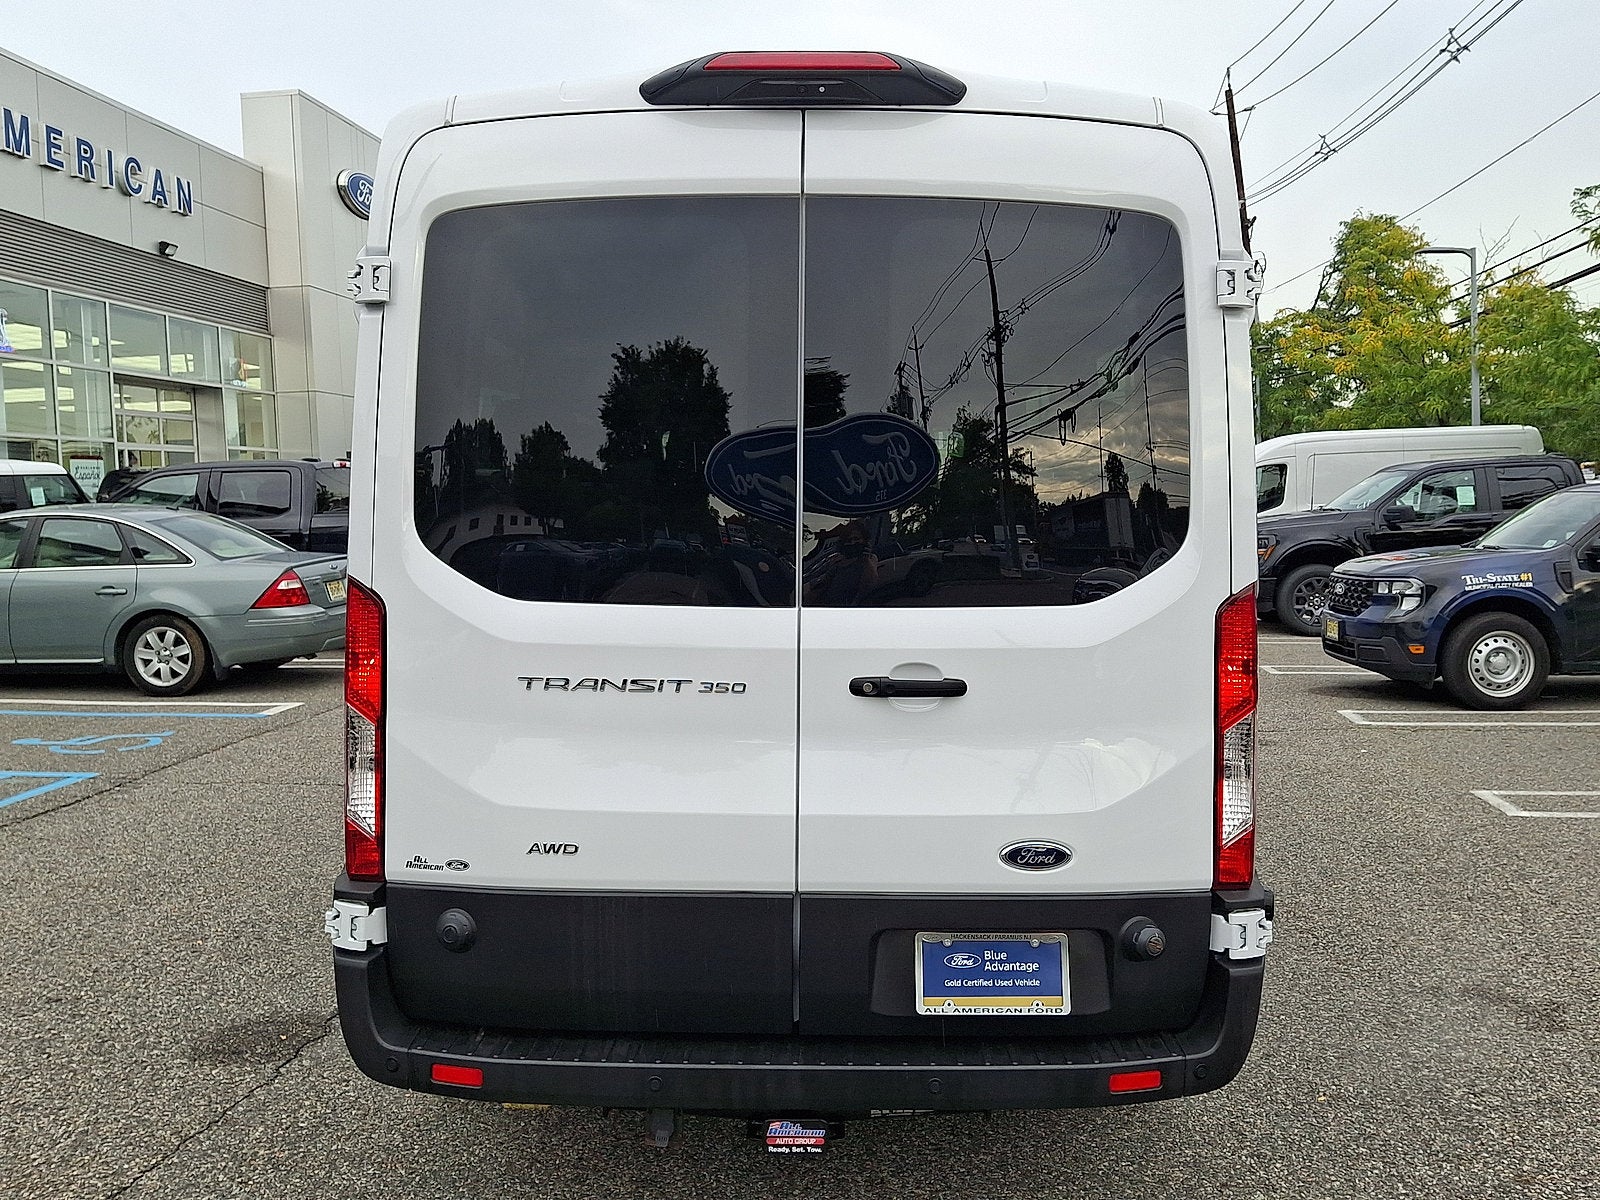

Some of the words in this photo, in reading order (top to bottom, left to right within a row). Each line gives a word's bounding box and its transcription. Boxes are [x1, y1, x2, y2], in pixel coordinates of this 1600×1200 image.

[517, 676, 693, 694] TRANSIT
[698, 681, 747, 695] 350
[526, 842, 580, 856] AWD
[1017, 847, 1057, 864] Ford
[951, 955, 975, 966] Ford
[984, 950, 1008, 960] Blue
[984, 961, 1040, 973] Advantage
[944, 979, 961, 987] Gold
[963, 979, 993, 987] Certified
[994, 979, 1013, 987] Used
[1014, 979, 1041, 987] Vehicle
